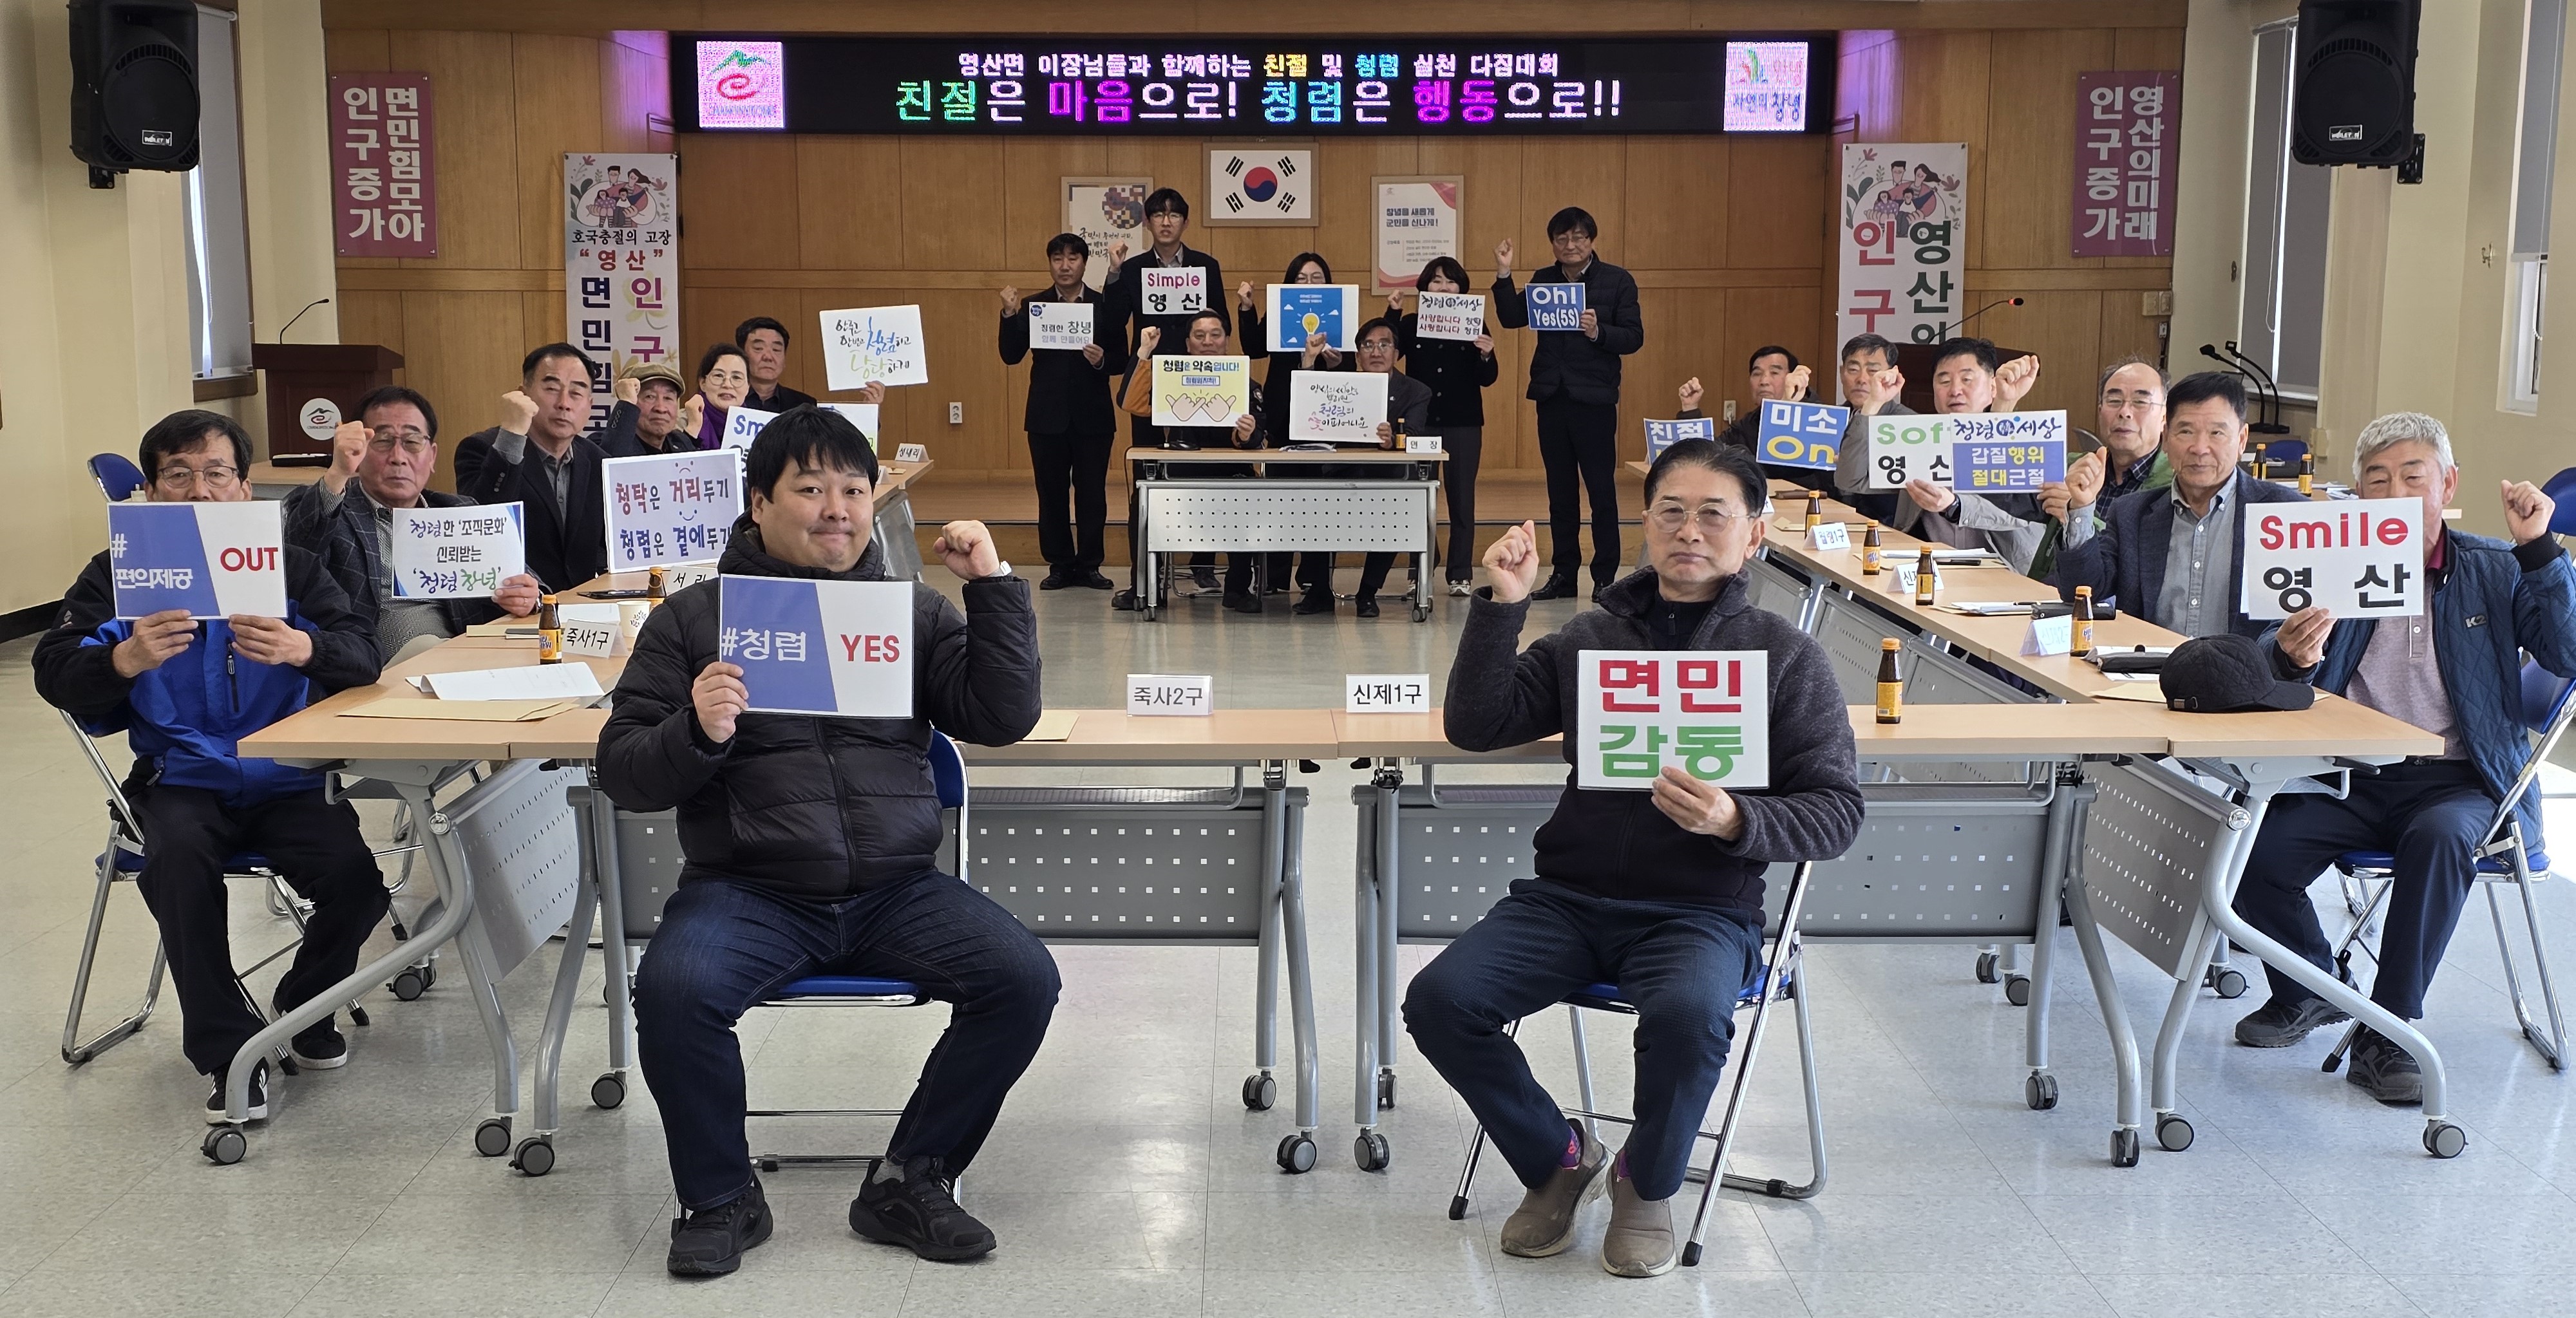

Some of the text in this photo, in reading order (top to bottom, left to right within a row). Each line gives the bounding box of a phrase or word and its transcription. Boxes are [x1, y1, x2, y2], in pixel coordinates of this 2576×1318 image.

[959, 53, 1558, 78] 영산면 이장님들과 함께하는 친절 및 청렴 실천 다짐대회
[896, 80, 1620, 122] 친절은 마음으로! 청렴은 행동으로!!
[343, 88, 385, 241] 인구증가
[2083, 86, 2124, 240] 인구증가
[572, 229, 672, 245] 호국충절의 고장
[1148, 273, 1200, 288] Simple
[1068, 321, 1091, 334] 창녕
[1533, 308, 1580, 328] Yes(5S)
[1163, 359, 1239, 372] 청렴은 약속입니다!
[1771, 404, 1837, 435] 미소
[1953, 418, 1994, 440] 청렴
[2016, 417, 2061, 439] 세상
[1877, 422, 1951, 444] Sof
[1766, 435, 1835, 464] On
[616, 476, 728, 515] 청탁은 거리두기
[410, 519, 455, 538] 청렴한
[2260, 512, 2409, 550] Smile
[620, 523, 731, 561] 청렴은 곁에두기
[220, 547, 278, 572] OUT
[437, 545, 482, 563] 신뢰받는
[115, 568, 193, 590] 편의제공
[2465, 615, 2486, 628] K2
[567, 628, 609, 650] 죽사1구
[721, 627, 900, 663] #청렴 YES
[1134, 687, 1204, 706] 죽사2구
[1354, 684, 1422, 705] 신제1구
[1599, 659, 1741, 713] 면민
[1599, 725, 1744, 780] 감동
